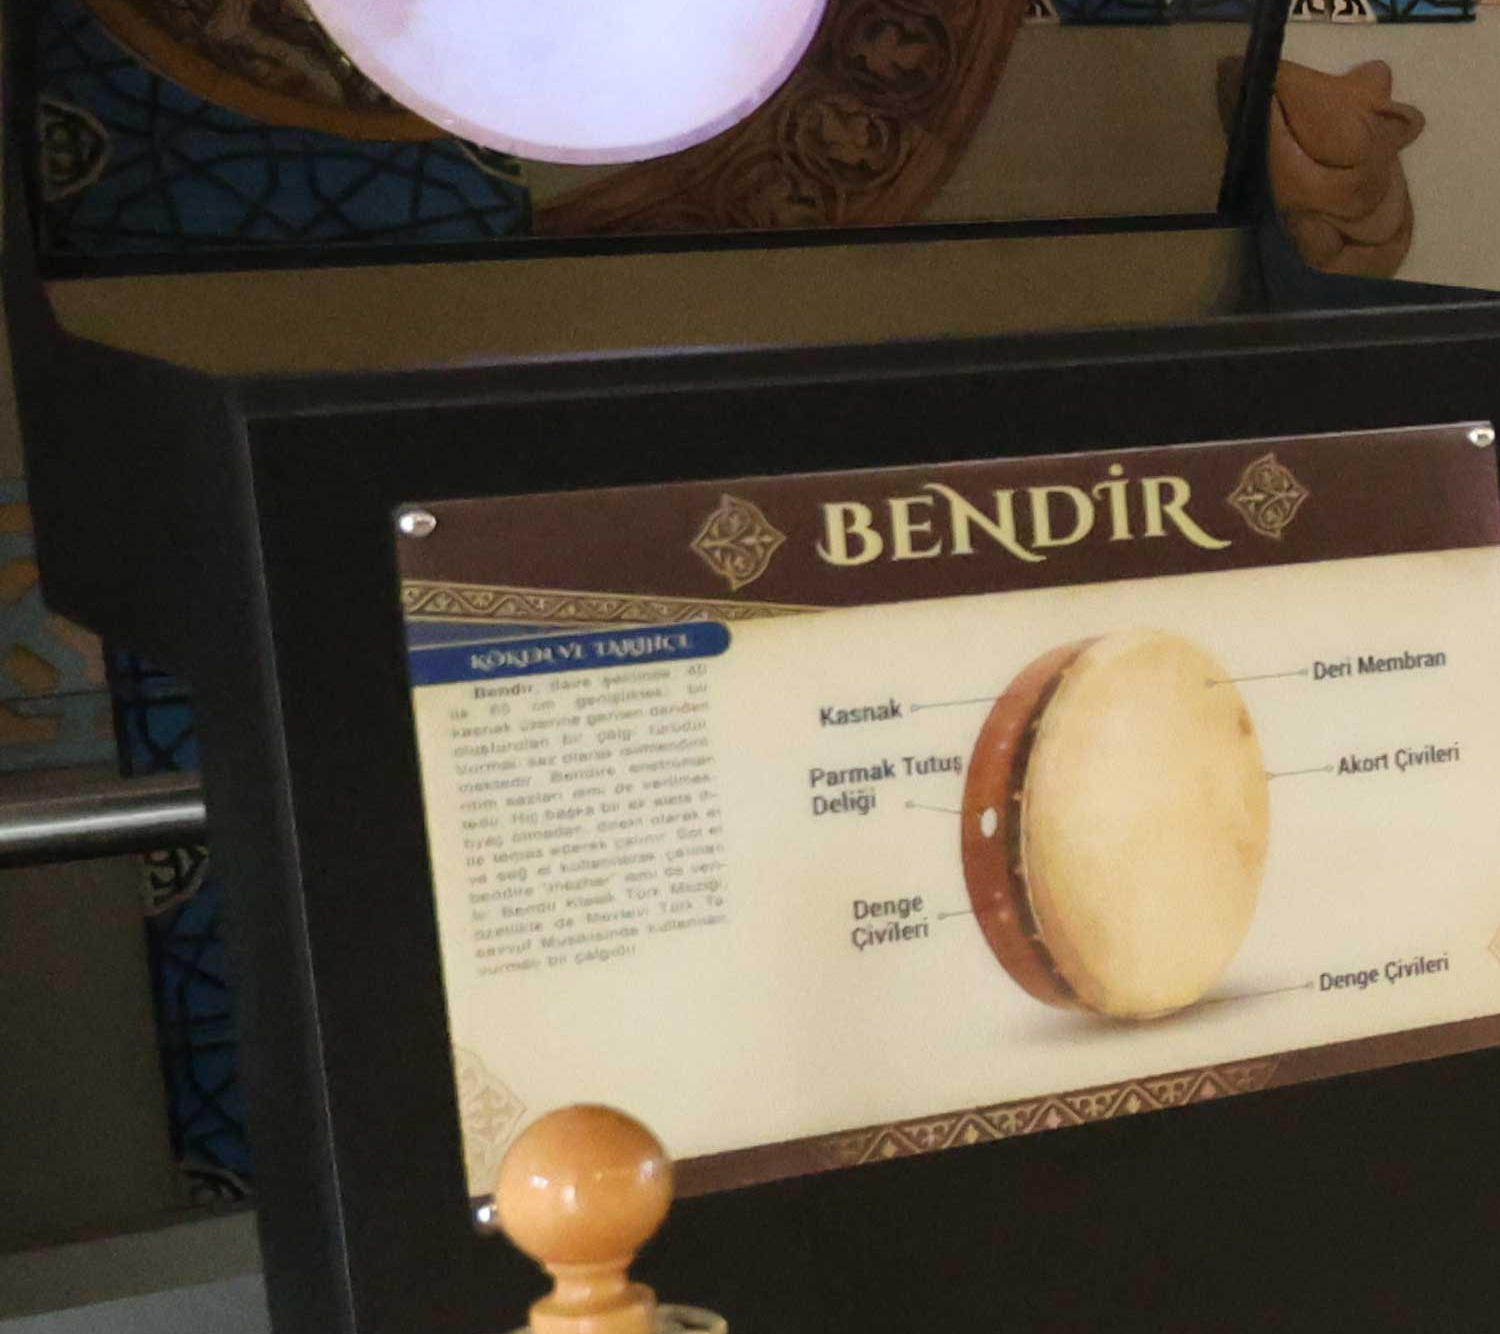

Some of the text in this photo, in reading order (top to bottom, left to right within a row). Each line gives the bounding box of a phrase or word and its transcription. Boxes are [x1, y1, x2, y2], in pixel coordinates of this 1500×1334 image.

[816, 464, 1231, 566] BENDİR
[1313, 651, 1446, 680] Deri Membran
[819, 698, 903, 727] Kasnak
[809, 755, 963, 788] Parmak Tutuş
[1337, 741, 1460, 775] Akort Çivileri
[813, 786, 876, 816] Deliği
[853, 896, 923, 920] Denge
[852, 917, 929, 951] Çivileri
[1319, 952, 1449, 991] Denge Çivileri
